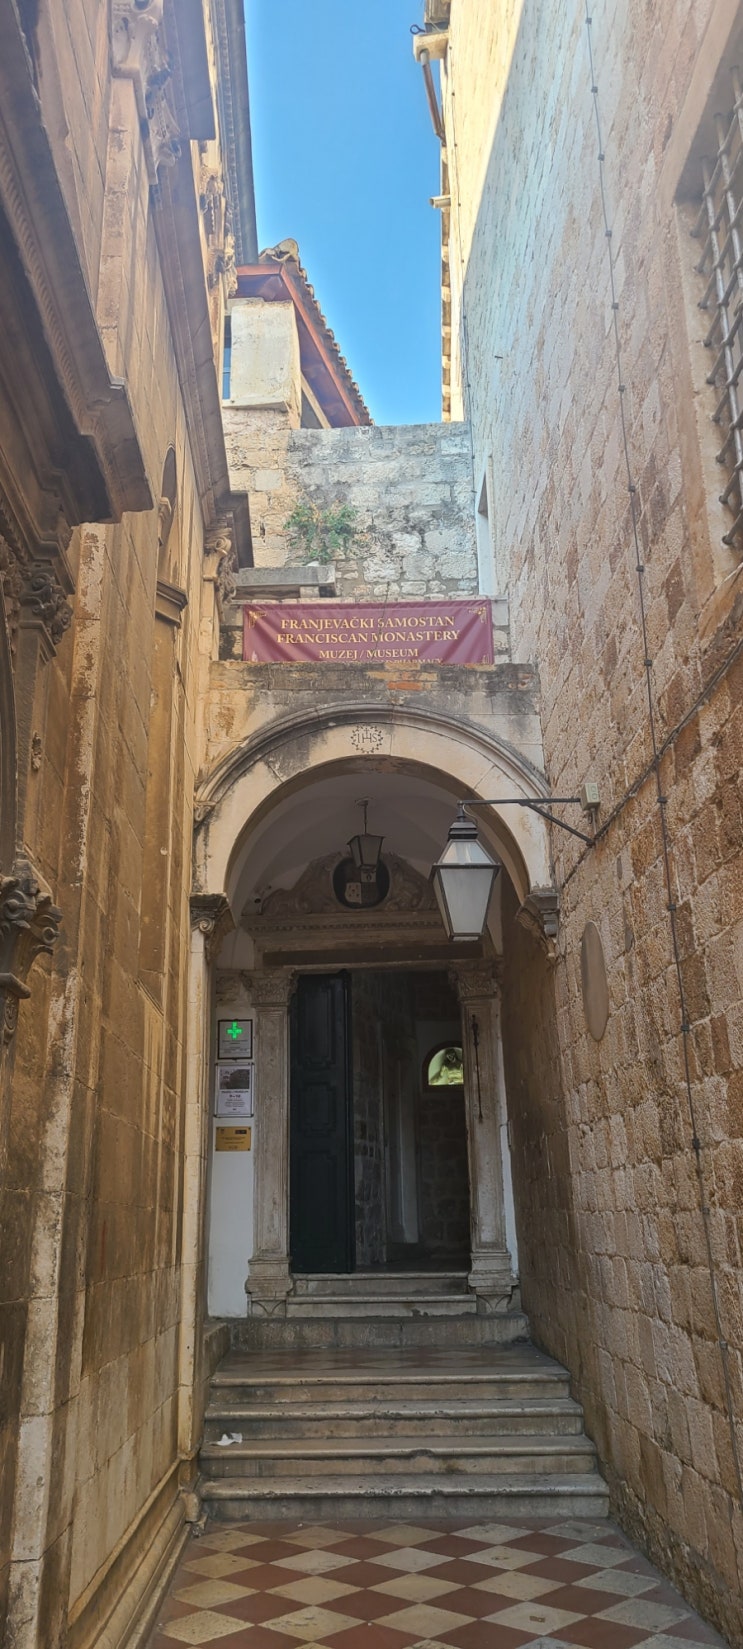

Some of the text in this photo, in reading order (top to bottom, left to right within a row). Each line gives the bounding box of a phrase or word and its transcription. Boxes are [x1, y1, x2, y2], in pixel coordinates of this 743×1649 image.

[281, 616, 455, 631] FRANJEVAČKI SAMOSTAN
[276, 630, 460, 644] FRANCISCAN MONASTERY
[319, 650, 358, 660] MUZEJ
[366, 649, 418, 658] MUSEUM
